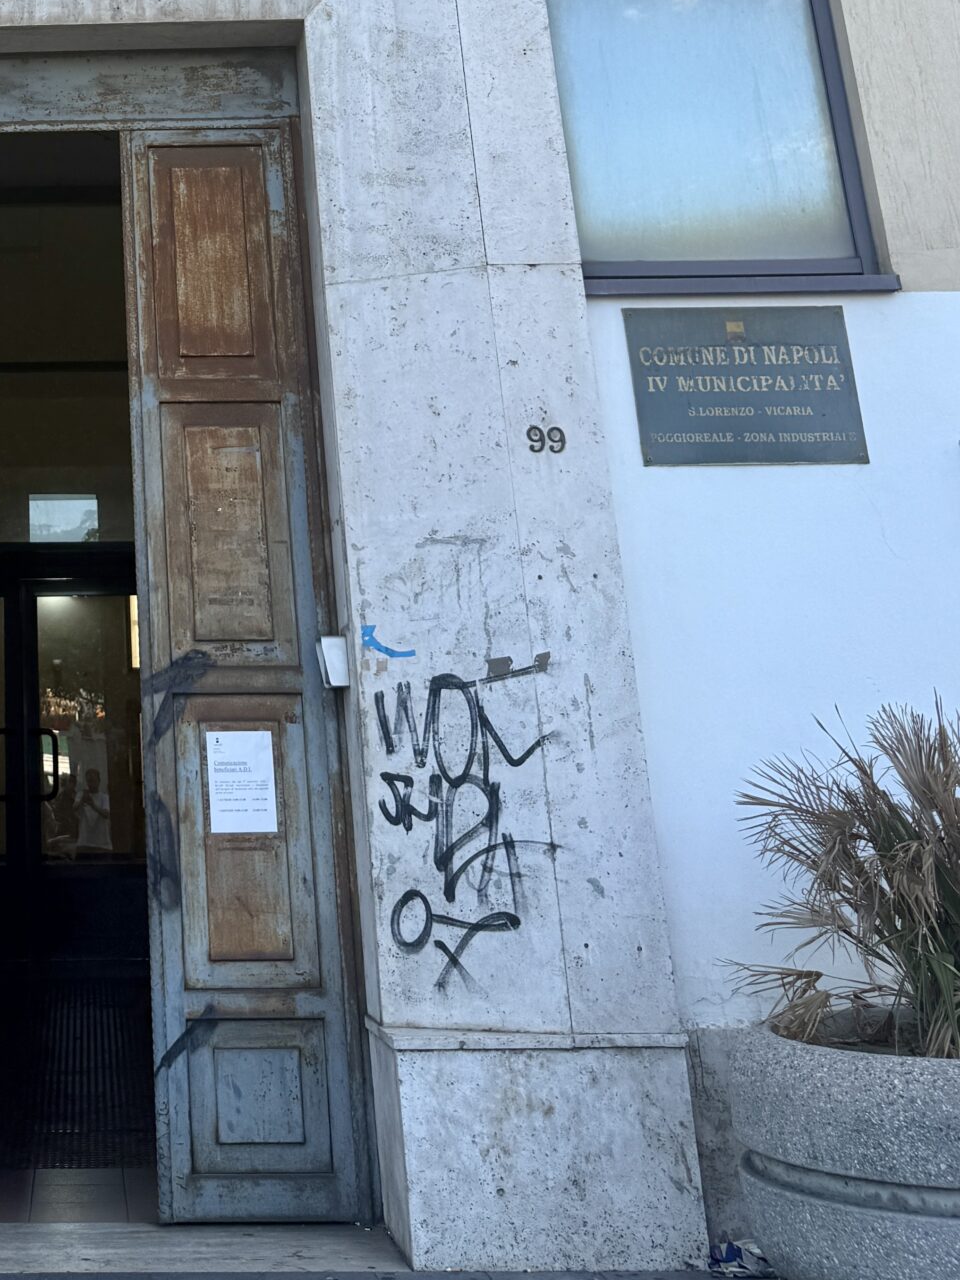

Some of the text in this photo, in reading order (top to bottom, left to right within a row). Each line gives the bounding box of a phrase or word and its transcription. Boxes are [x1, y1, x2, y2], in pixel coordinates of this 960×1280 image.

[639, 345, 841, 366] COMUNE DI NAPOLI
[647, 376, 668, 392] IV
[688, 406, 755, 417] S.LORENZO
[765, 406, 814, 417] VICARIA
[526, 424, 566, 453] 99
[650, 432, 735, 443] POGGIOREALE
[744, 432, 776, 443] ZONA
